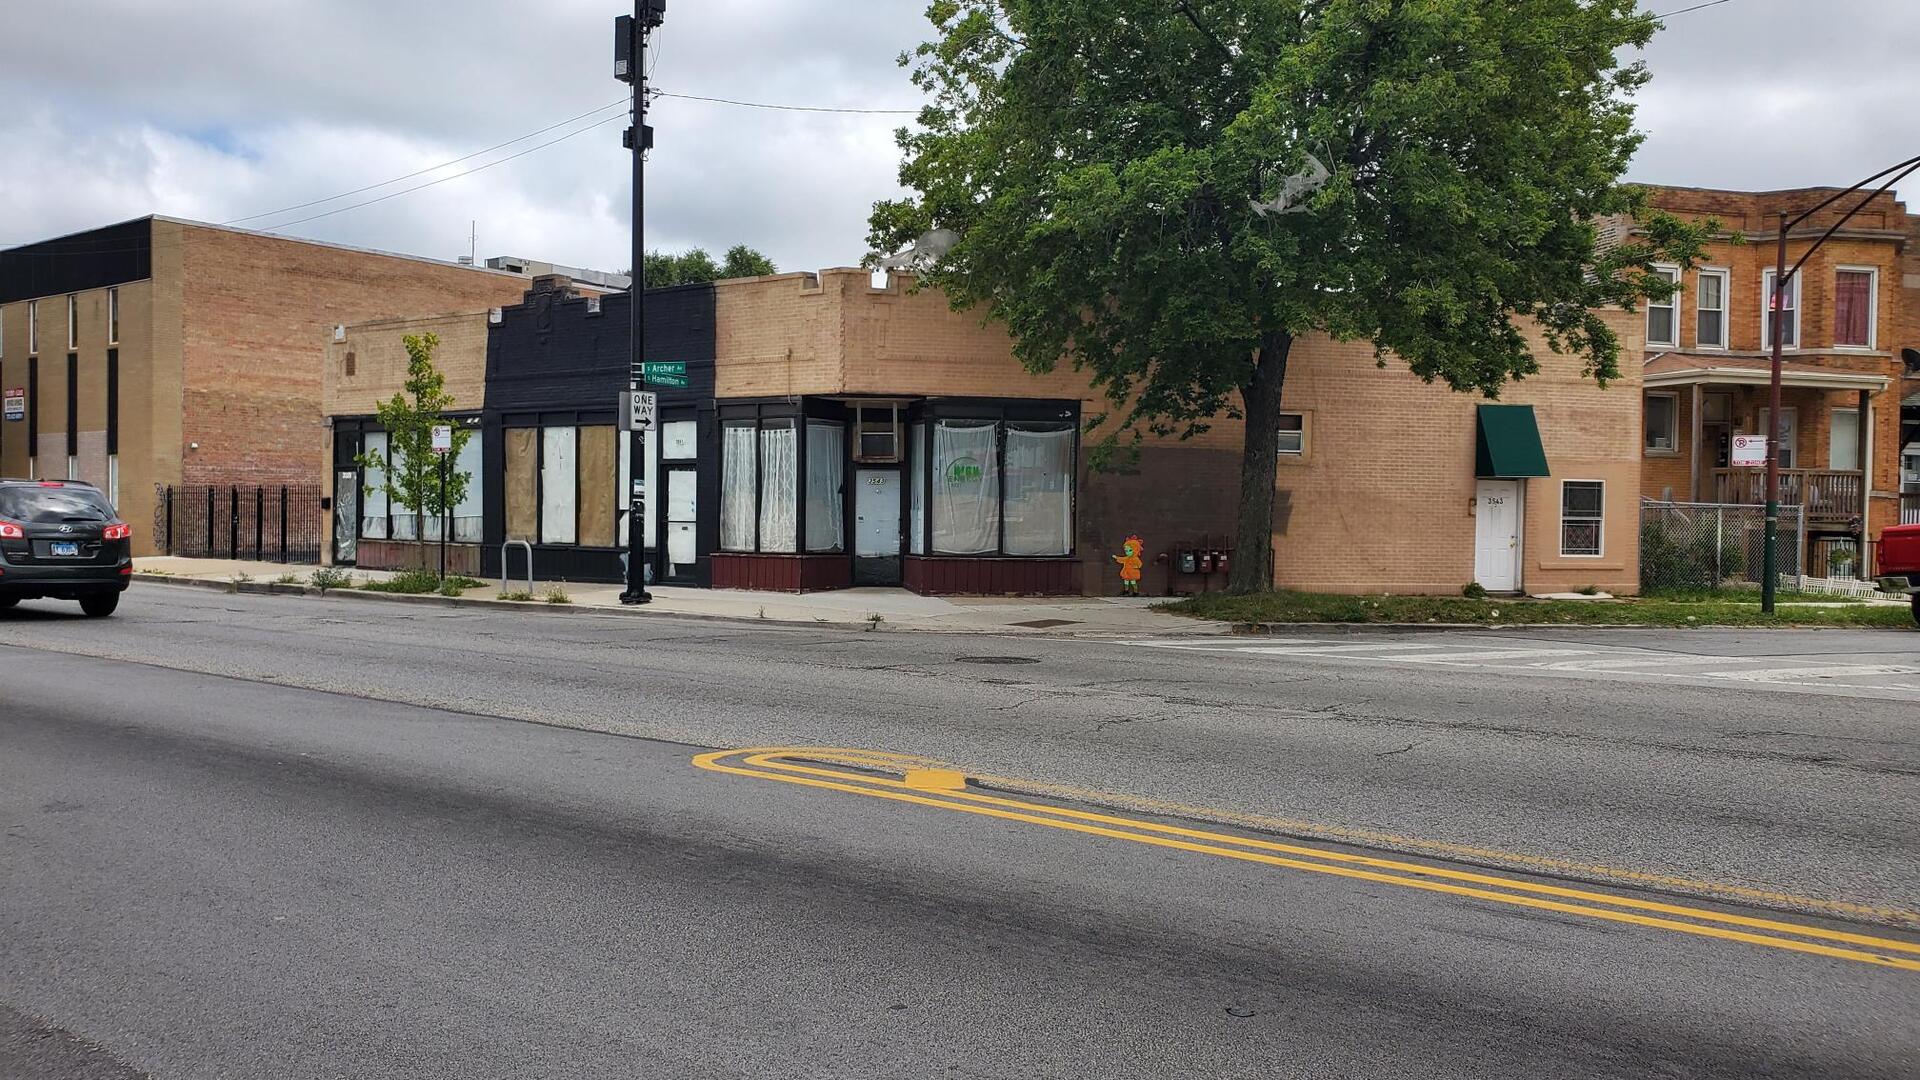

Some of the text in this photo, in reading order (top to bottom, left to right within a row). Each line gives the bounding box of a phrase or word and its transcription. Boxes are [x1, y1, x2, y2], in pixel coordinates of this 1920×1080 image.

[652, 364, 675, 372] Archer
[652, 375, 679, 385] Hamilton
[634, 394, 653, 405] ONE
[634, 405, 653, 415] WAY
